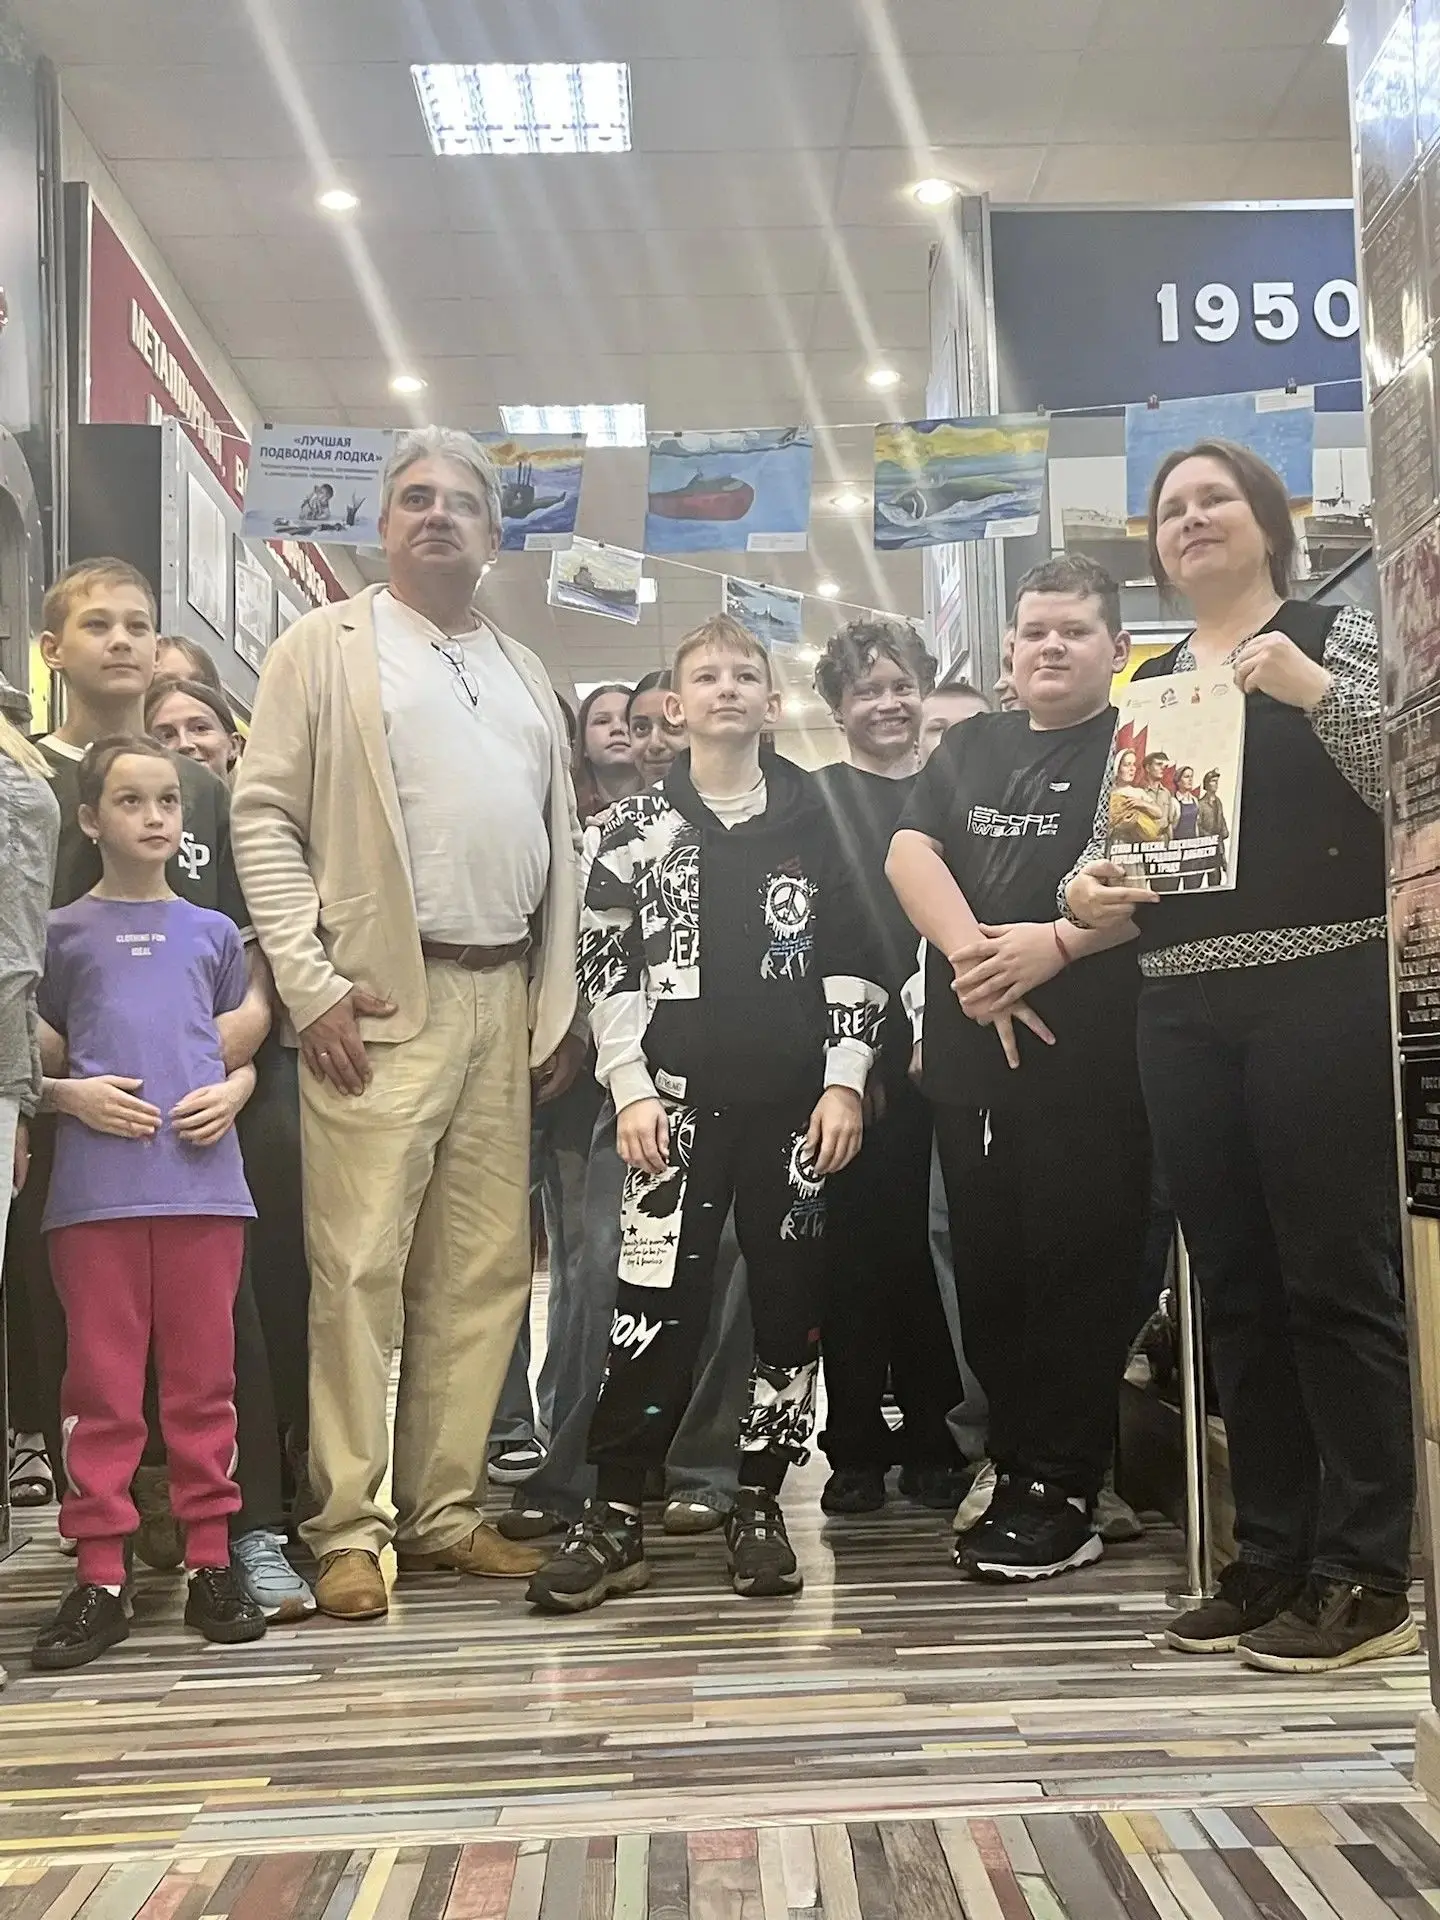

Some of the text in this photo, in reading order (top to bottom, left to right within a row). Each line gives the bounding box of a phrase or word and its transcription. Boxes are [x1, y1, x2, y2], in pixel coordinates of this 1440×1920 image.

[1157, 279, 1360, 342] 1950
[294, 435, 352, 448] «ЛУЧШАЯ
[260, 446, 383, 463] ПОДВОДНАЯ ЛОДКА»
